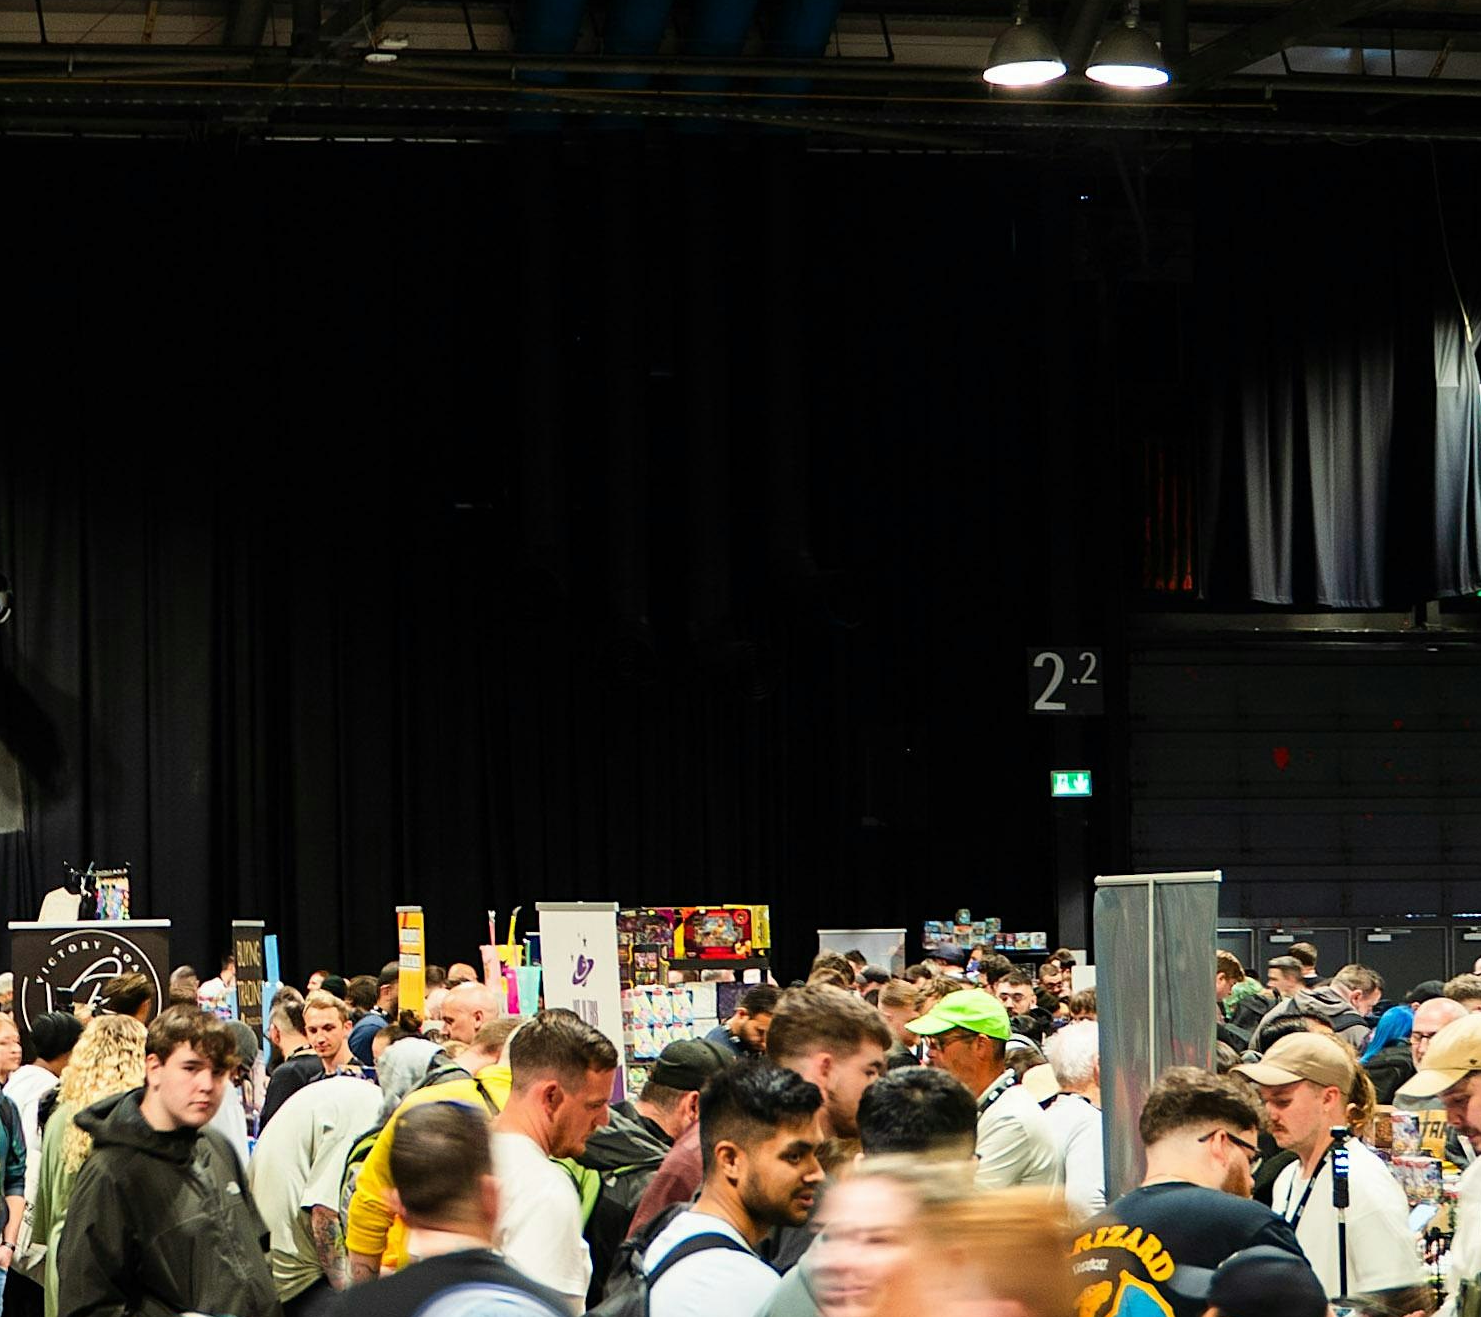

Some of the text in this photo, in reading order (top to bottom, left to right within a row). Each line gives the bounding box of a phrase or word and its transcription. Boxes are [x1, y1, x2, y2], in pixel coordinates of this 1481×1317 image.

[1033, 651, 1098, 711] 2.2
[36, 940, 102, 983] VICTORY
[1068, 1224, 1176, 1282] RIZARD
